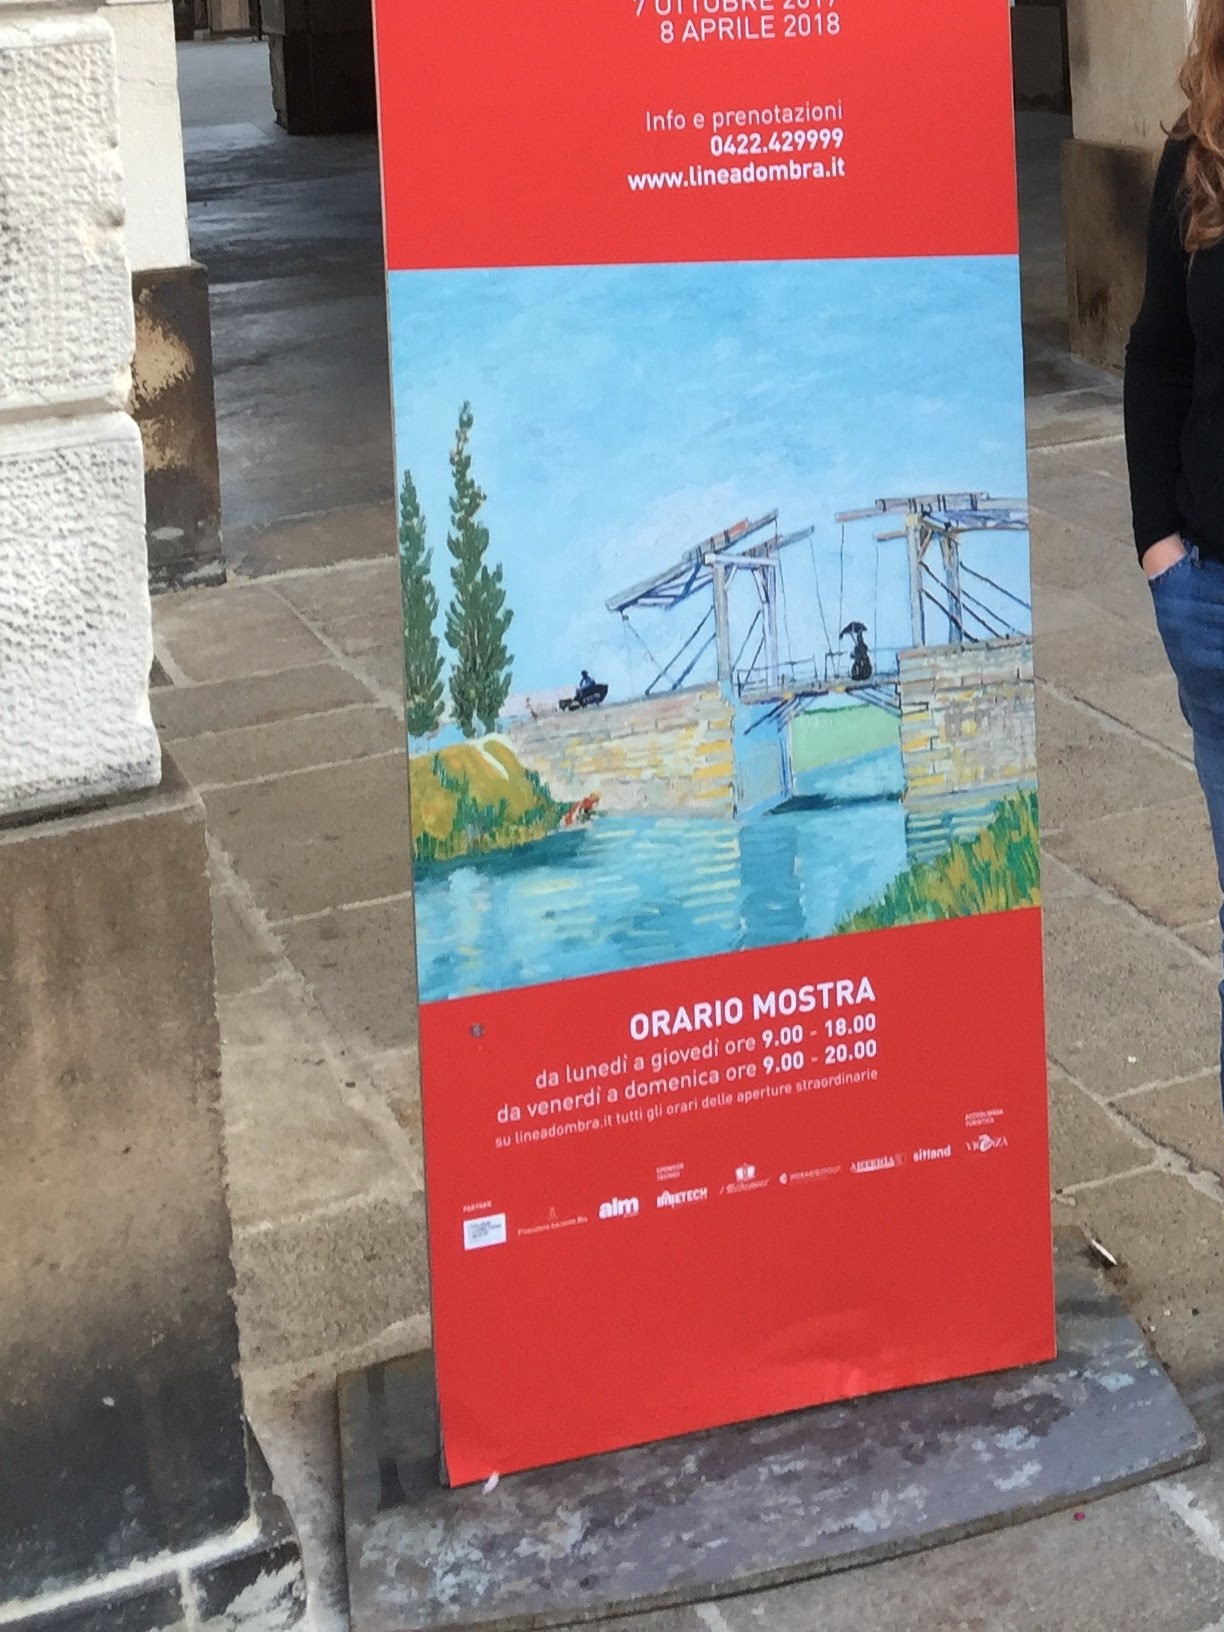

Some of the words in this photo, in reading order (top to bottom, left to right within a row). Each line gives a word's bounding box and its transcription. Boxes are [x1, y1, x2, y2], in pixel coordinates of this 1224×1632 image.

[660, 20, 674, 44] 8
[682, 15, 775, 43] APRILE
[784, 12, 840, 37] 2018
[646, 110, 686, 132] Info
[693, 113, 705, 129] e
[712, 98, 843, 132] prenotazioni
[710, 127, 844, 156] 0422.429999
[627, 156, 845, 191] www.lineadombra.it
[630, 997, 743, 1040] ORARIO
[752, 976, 876, 1020] MOSTRA
[535, 1069, 559, 1089] da
[634, 1056, 644, 1071] a
[725, 1036, 756, 1055] ore
[762, 1024, 803, 1049] 9.00
[824, 1013, 876, 1038] 18.00
[497, 1103, 521, 1123] da
[607, 1088, 618, 1103] a
[625, 1069, 719, 1100] domenica
[726, 1063, 757, 1082] ore
[763, 1050, 804, 1075] 9.00
[824, 1039, 877, 1065] 20.00
[495, 1133, 511, 1149] su
[515, 1114, 612, 1144] lineadombra.it
[616, 1107, 643, 1125] tutti
[647, 1104, 662, 1122] gli
[666, 1099, 698, 1115] orari
[702, 1093, 733, 1109] delle
[737, 1082, 792, 1104] aperture
[796, 1067, 878, 1092] straordinarie
